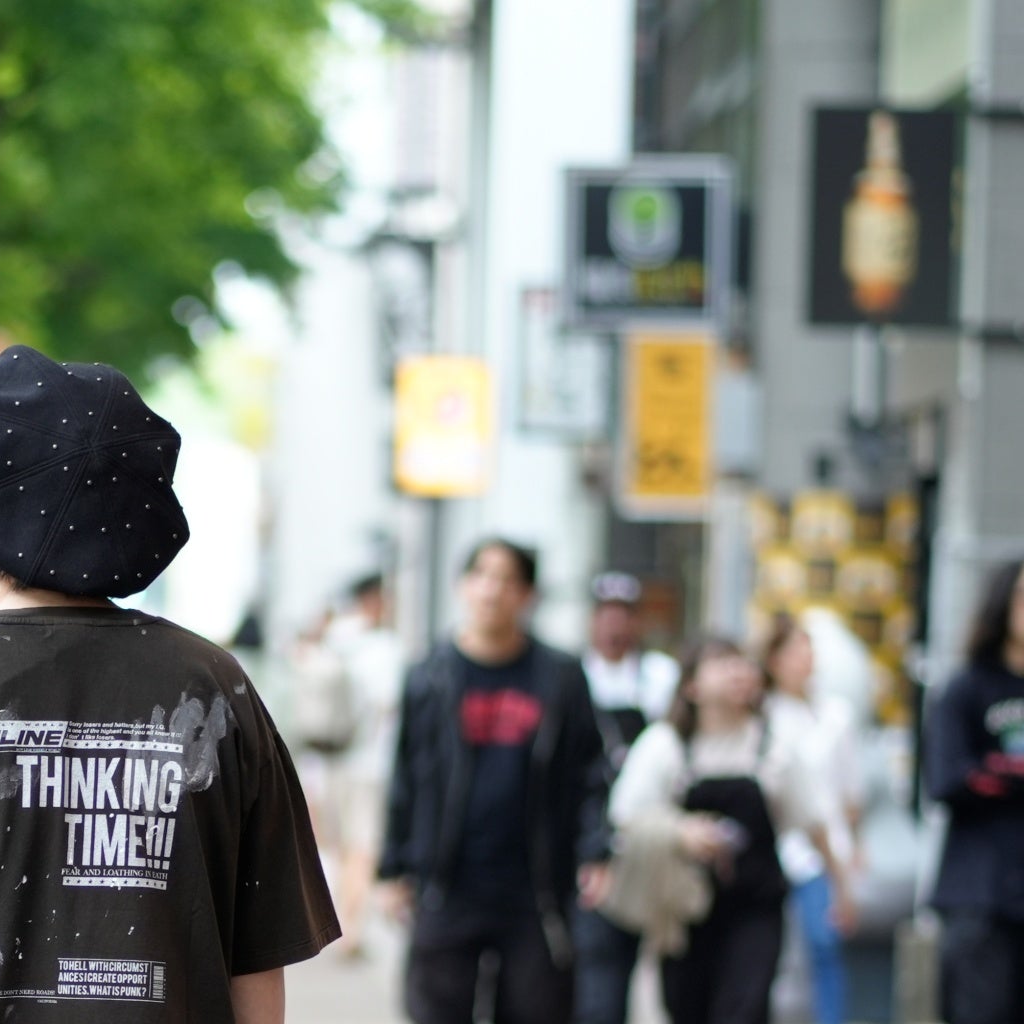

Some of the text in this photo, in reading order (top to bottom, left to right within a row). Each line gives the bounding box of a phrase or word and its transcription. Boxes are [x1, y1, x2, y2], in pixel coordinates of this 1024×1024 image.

[16, 755, 183, 813] THINKING
[64, 813, 176, 870] TIME!!!
[61, 867, 80, 876] FEAR
[102, 868, 144, 877] LOATHING
